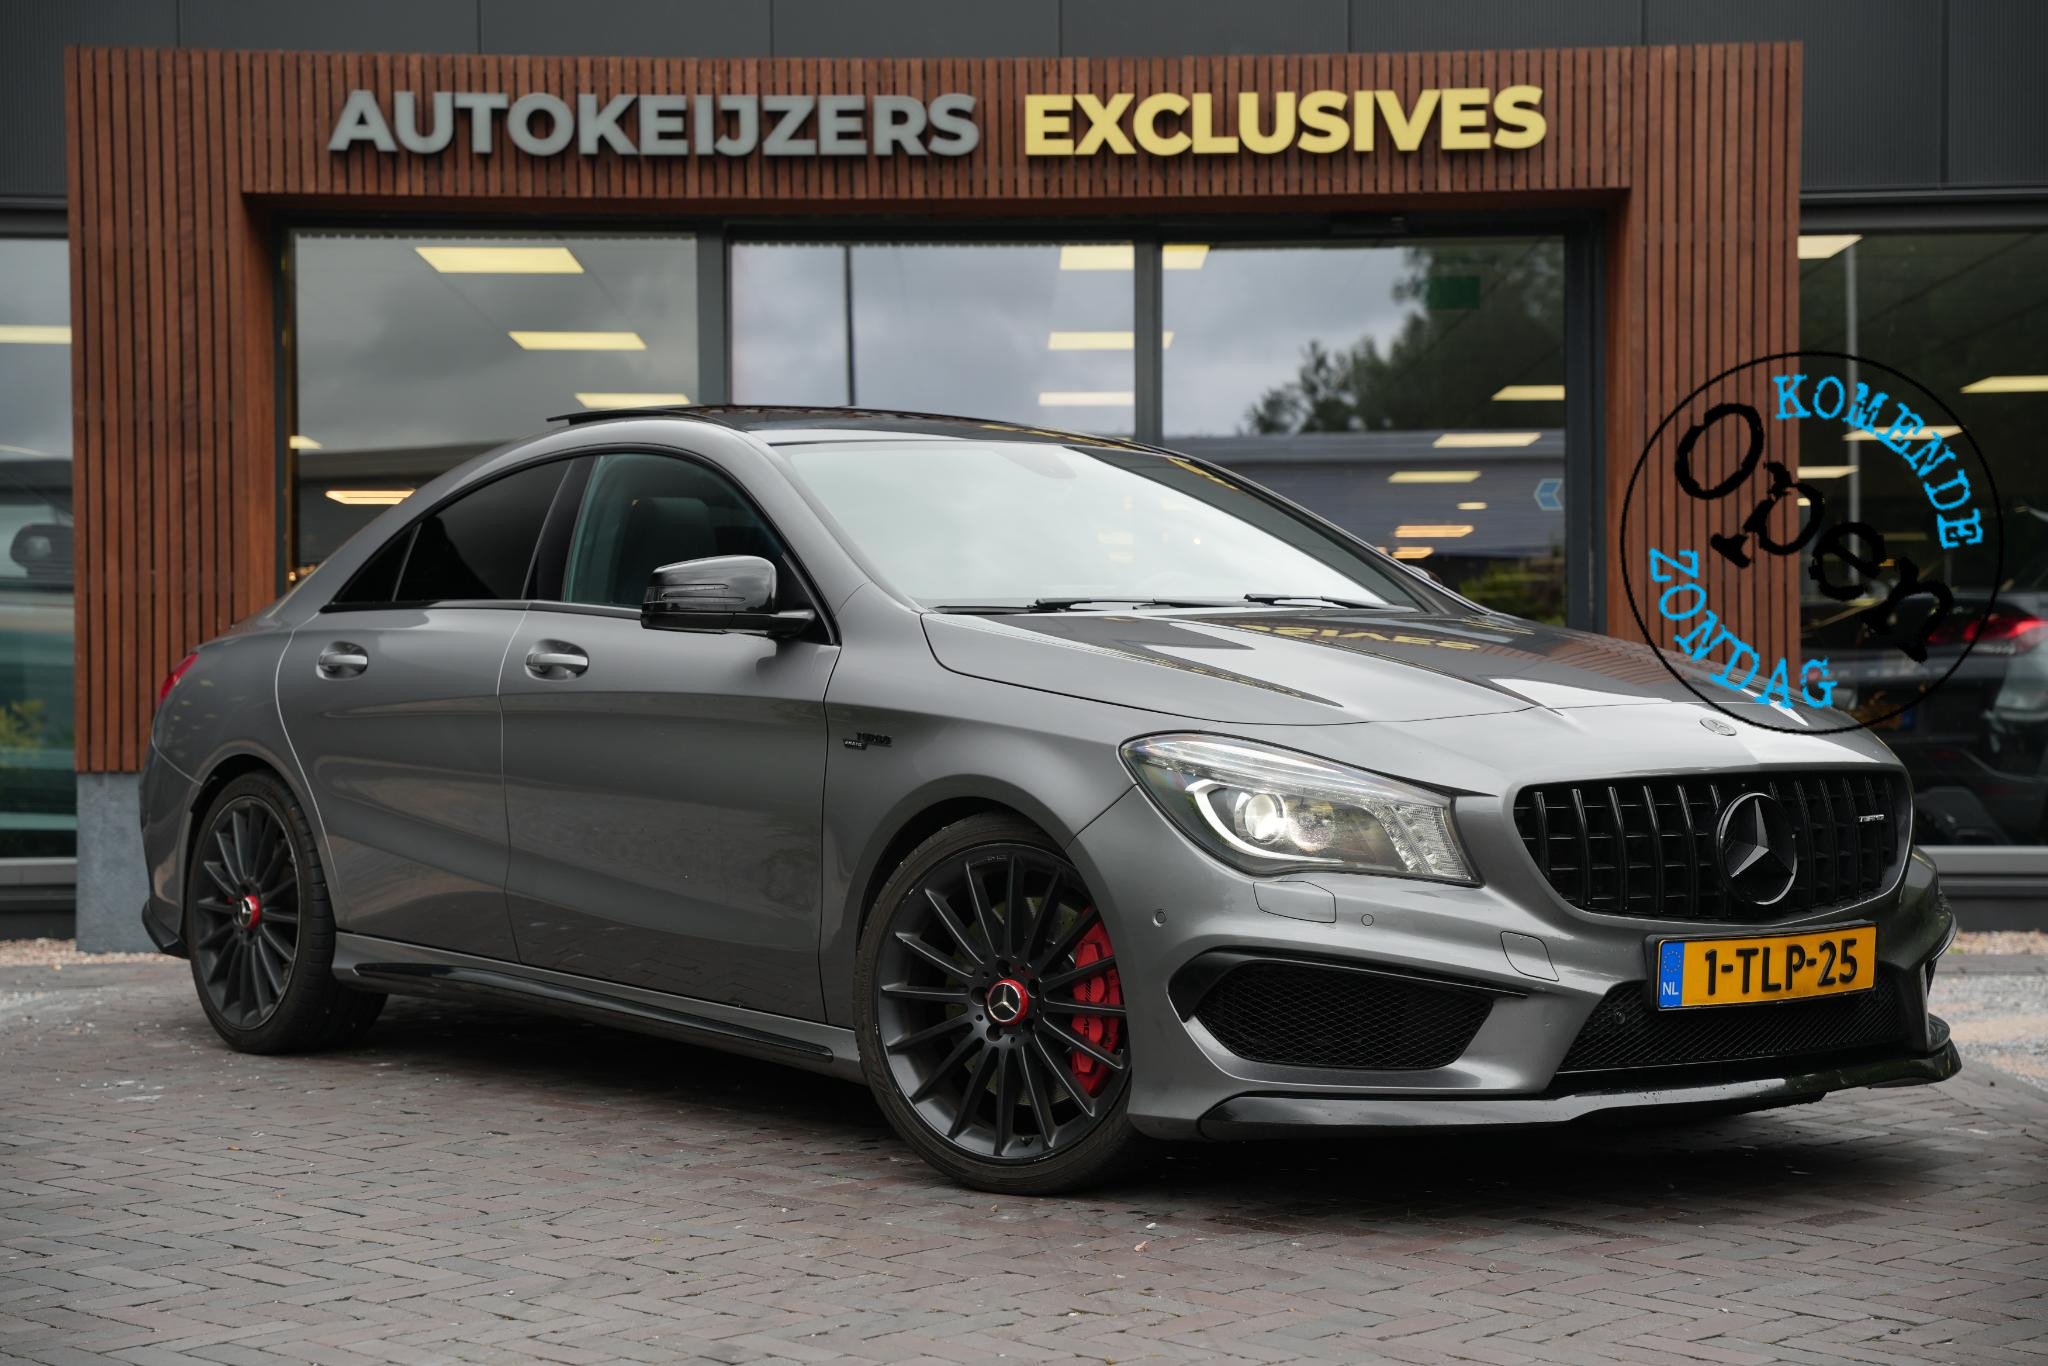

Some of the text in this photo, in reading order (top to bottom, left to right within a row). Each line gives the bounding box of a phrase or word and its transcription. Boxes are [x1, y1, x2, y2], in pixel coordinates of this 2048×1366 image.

[328, 85, 1547, 156] AUTOKEIJZERS EXCLUSIVES
[1662, 981, 1679, 996] NL
[1704, 938, 1858, 996] 1-TLP-25
